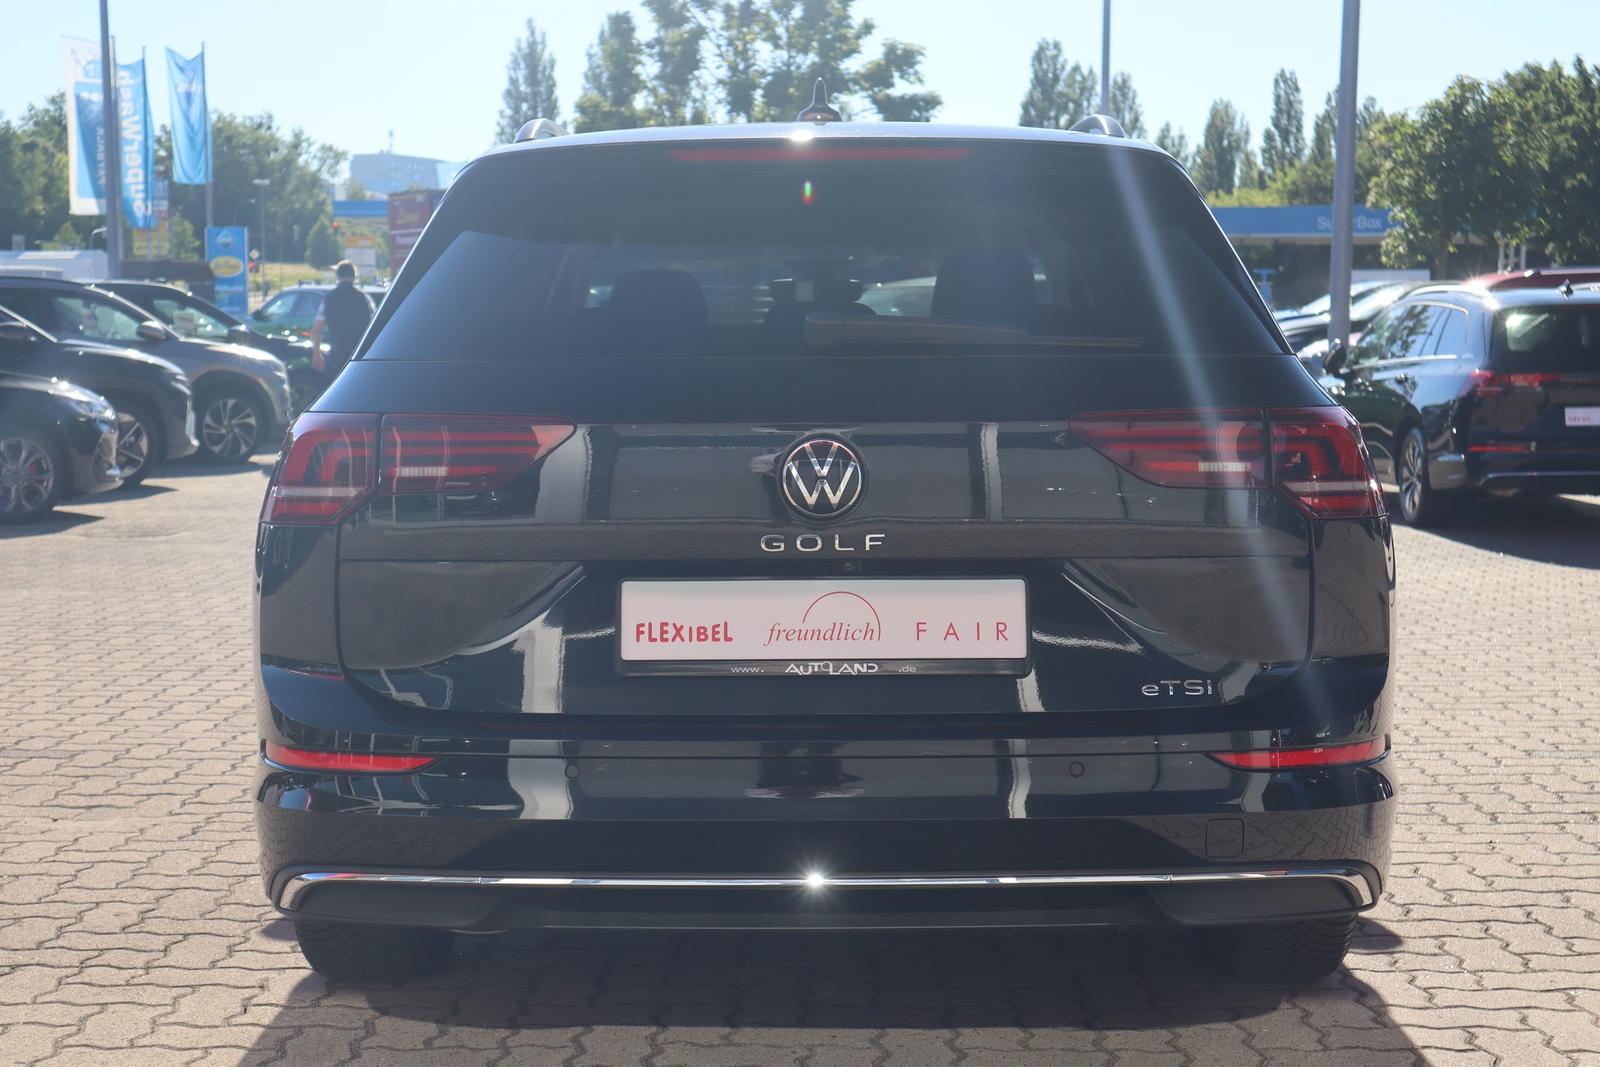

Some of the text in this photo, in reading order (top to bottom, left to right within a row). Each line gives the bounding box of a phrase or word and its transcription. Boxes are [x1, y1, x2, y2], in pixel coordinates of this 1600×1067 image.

[760, 533, 886, 552] GOLF
[635, 621, 1009, 647] FLEXIBEL freundlich FAIR
[785, 661, 879, 676] AUTOLAND
